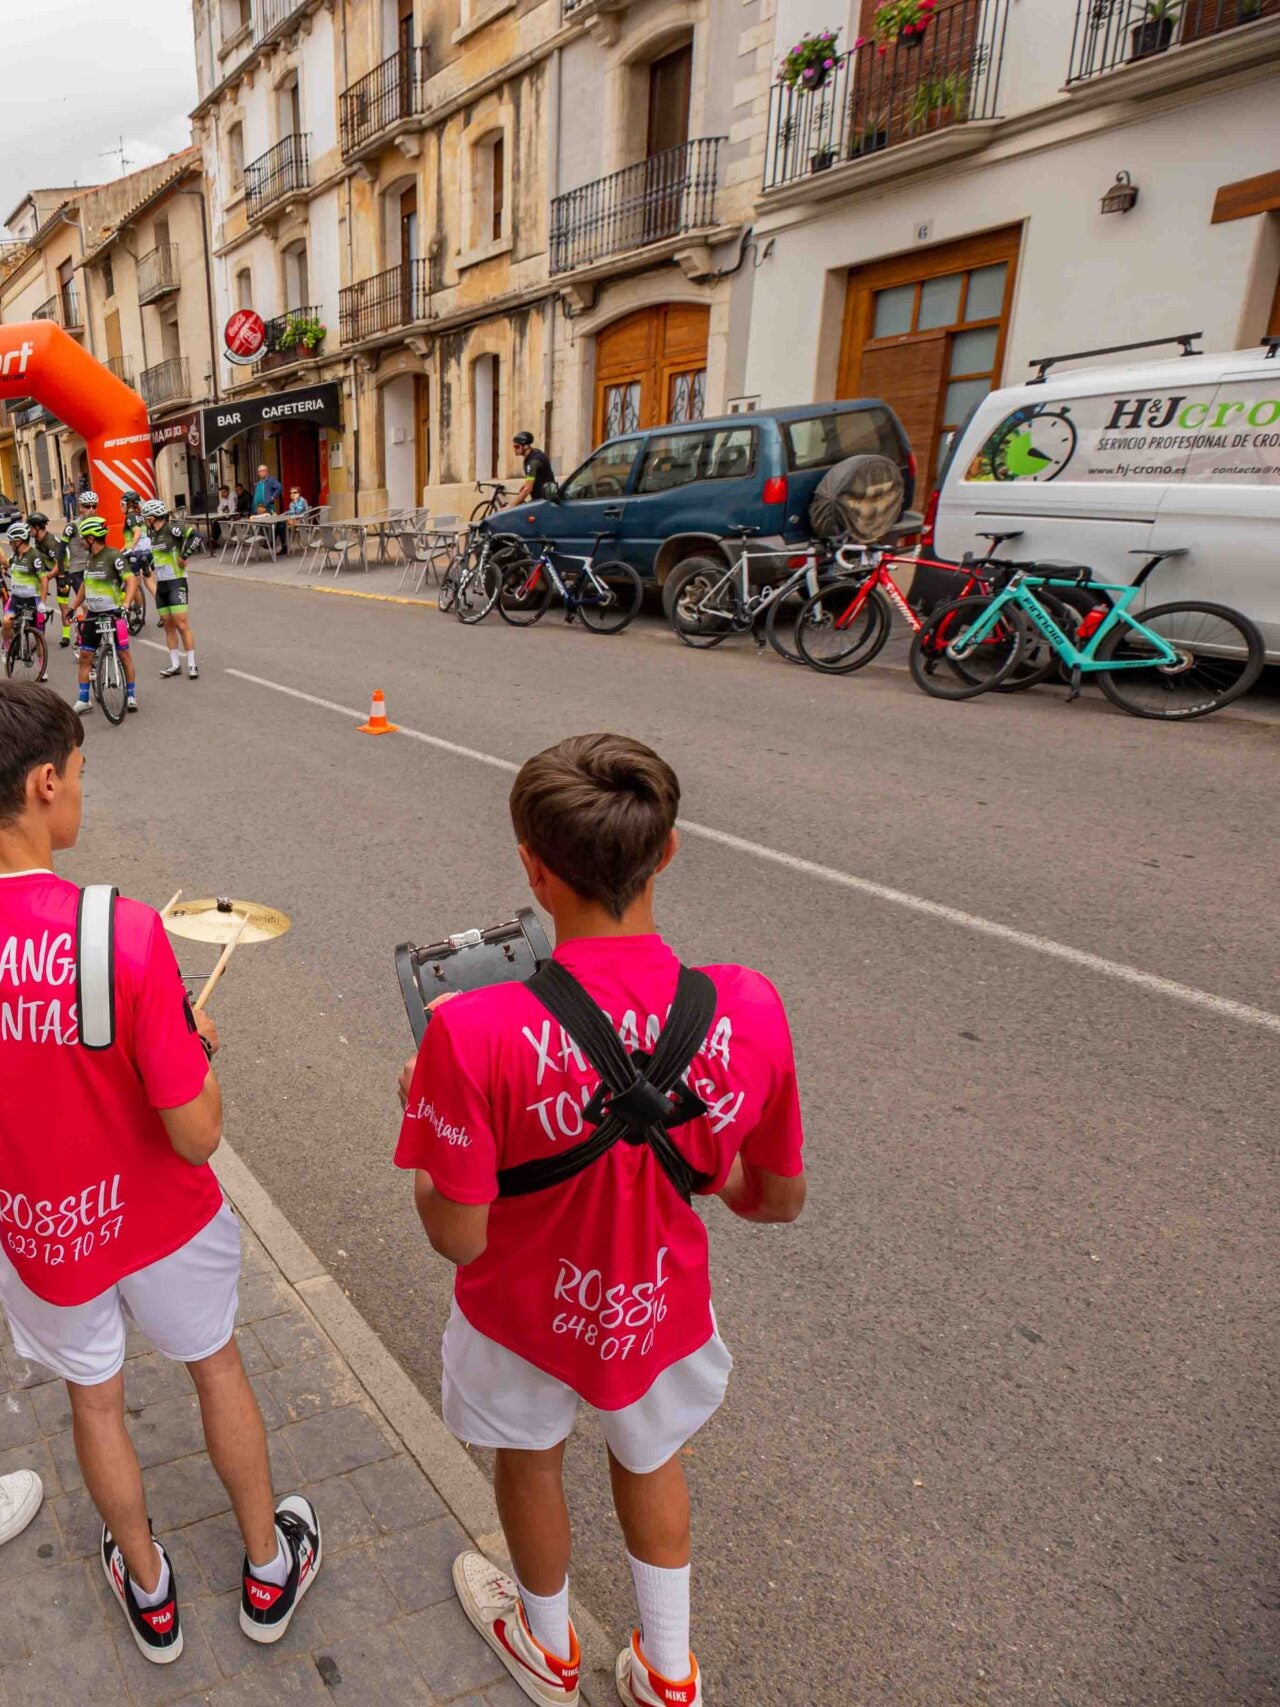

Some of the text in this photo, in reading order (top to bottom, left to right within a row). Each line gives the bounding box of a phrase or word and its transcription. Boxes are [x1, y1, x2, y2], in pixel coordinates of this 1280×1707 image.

[217, 399, 324, 427] BAR CAFETERIA
[1097, 436, 1146, 451] SERVICIO
[1149, 434, 1227, 449] PROFESIONAL
[1231, 434, 1249, 447] DE
[1087, 463, 1187, 476] www.hj-crono.es
[7, 1215, 123, 1266] 623 12 70 57
[552, 1312, 598, 1346] 648
[600, 1334, 637, 1361] 07
[251, 1586, 271, 1601] FILA
[152, 1612, 171, 1625] FILA
[664, 1688, 688, 1703] NIKE
